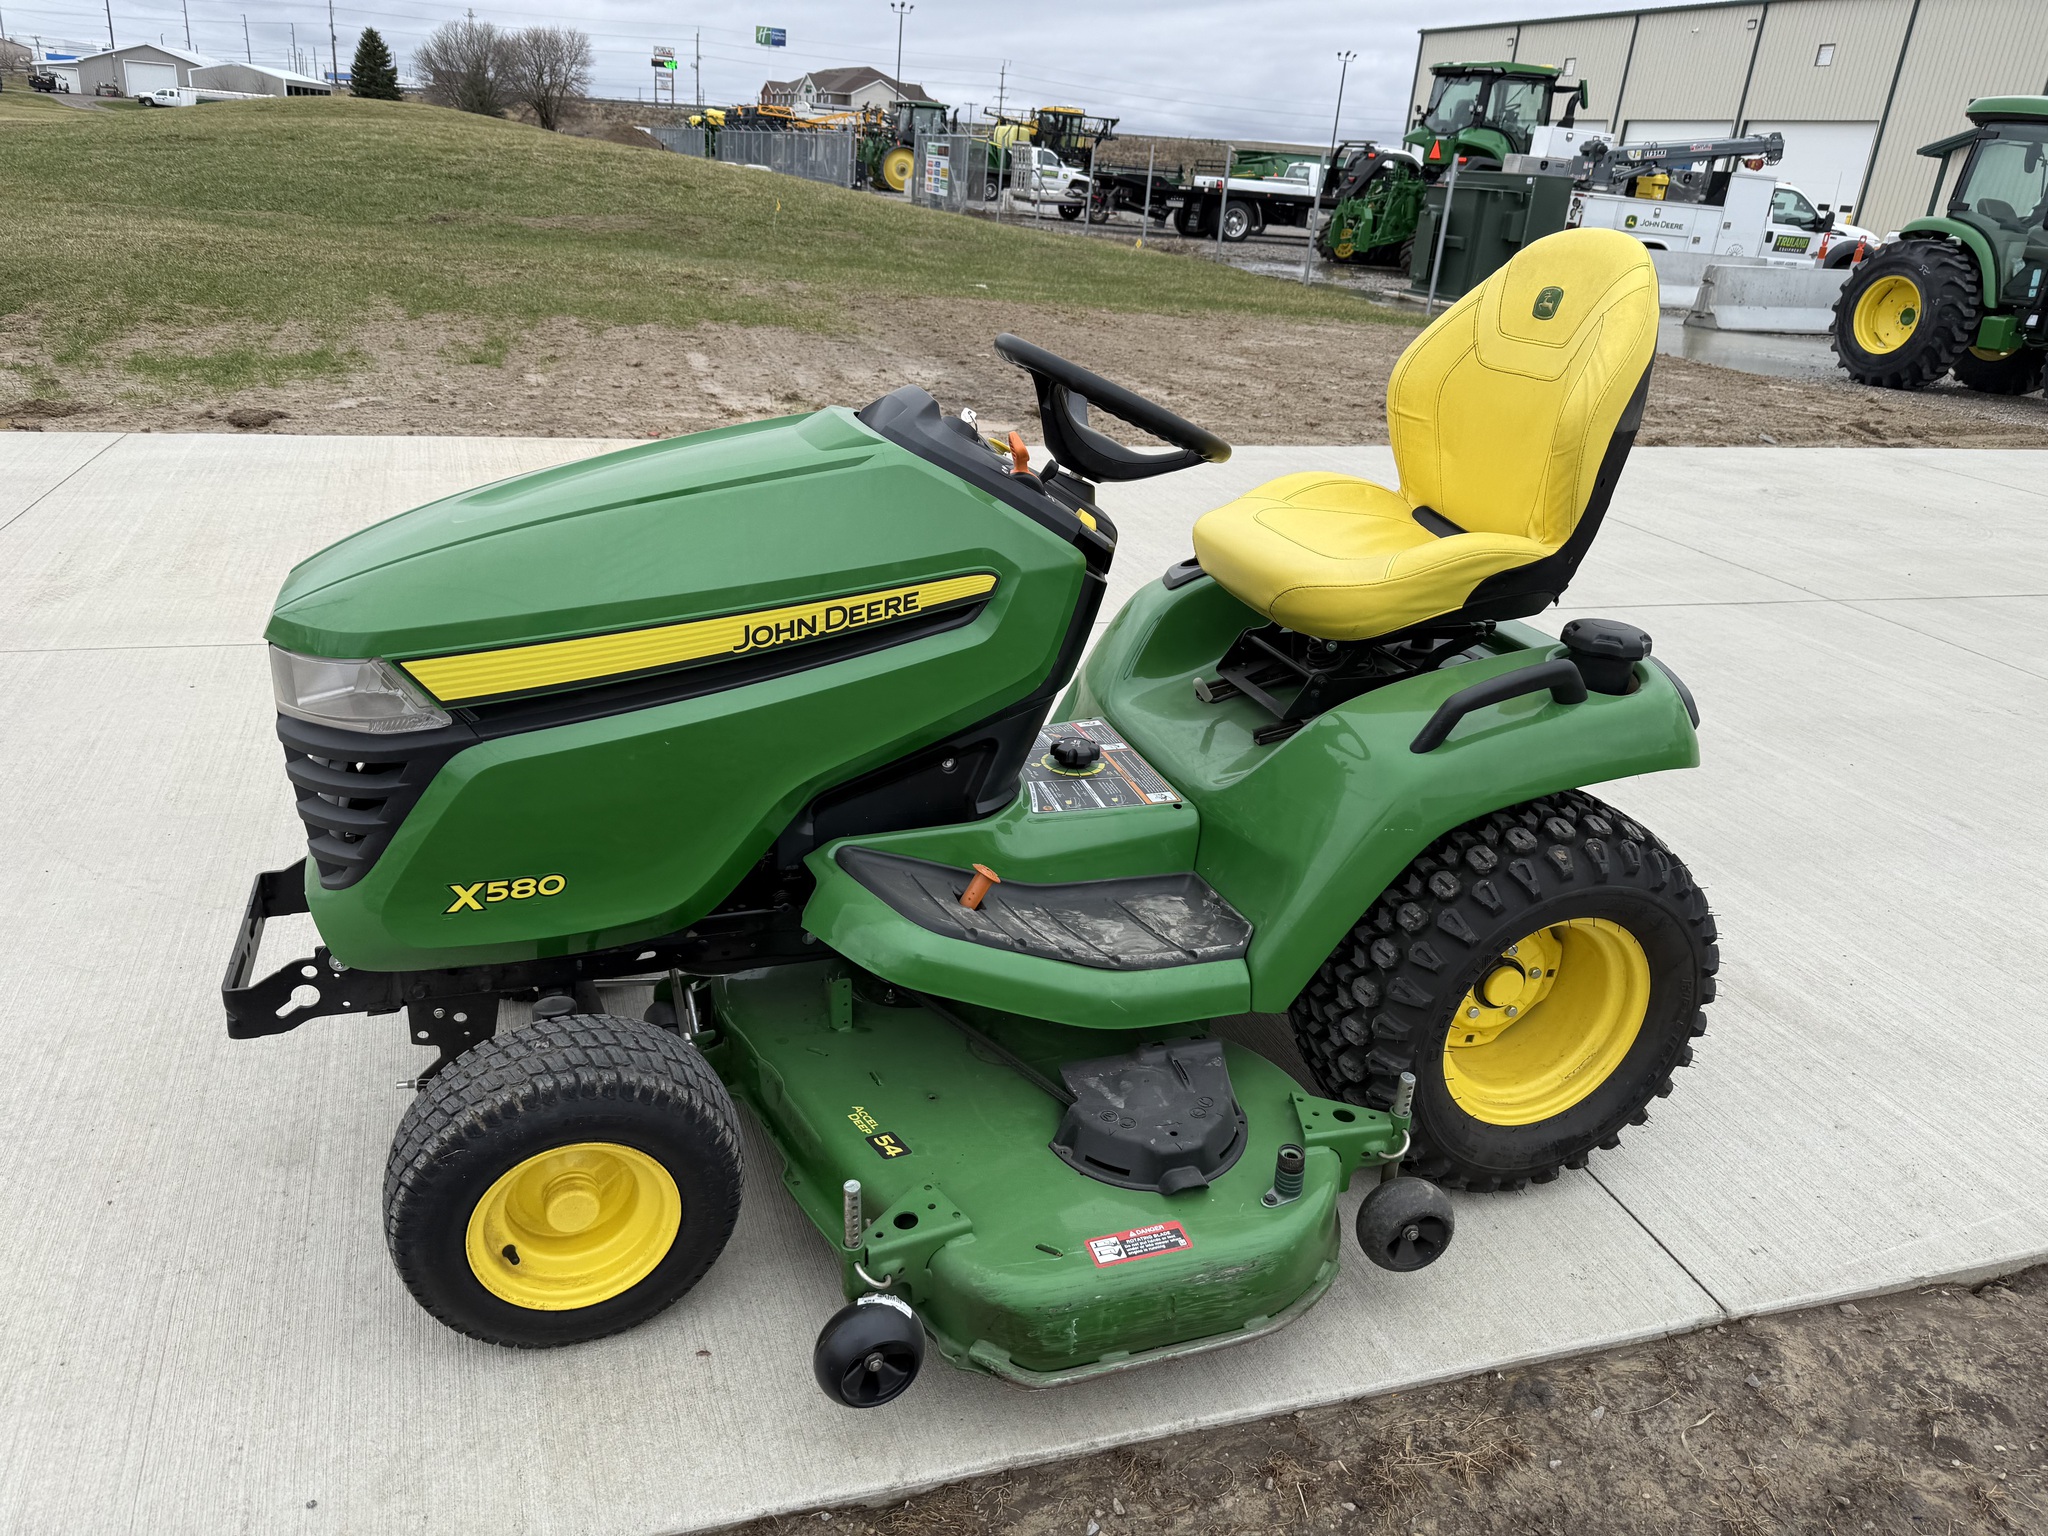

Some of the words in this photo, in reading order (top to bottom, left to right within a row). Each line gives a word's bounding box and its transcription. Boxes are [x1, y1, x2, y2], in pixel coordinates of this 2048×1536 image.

[1640, 219, 1660, 228] JOHN
[1661, 220, 1684, 230] DEERE
[1777, 236, 1808, 248] TRULAND
[733, 615, 817, 653] JOHN
[825, 591, 921, 631] DEERE
[443, 874, 567, 914] X580
[847, 1113, 872, 1134] DEEP
[851, 1106, 879, 1130] ACCEL
[873, 1134, 903, 1157] 54
[1126, 1235, 1153, 1244] ROTATING
[1135, 1224, 1165, 1235] DANGER
